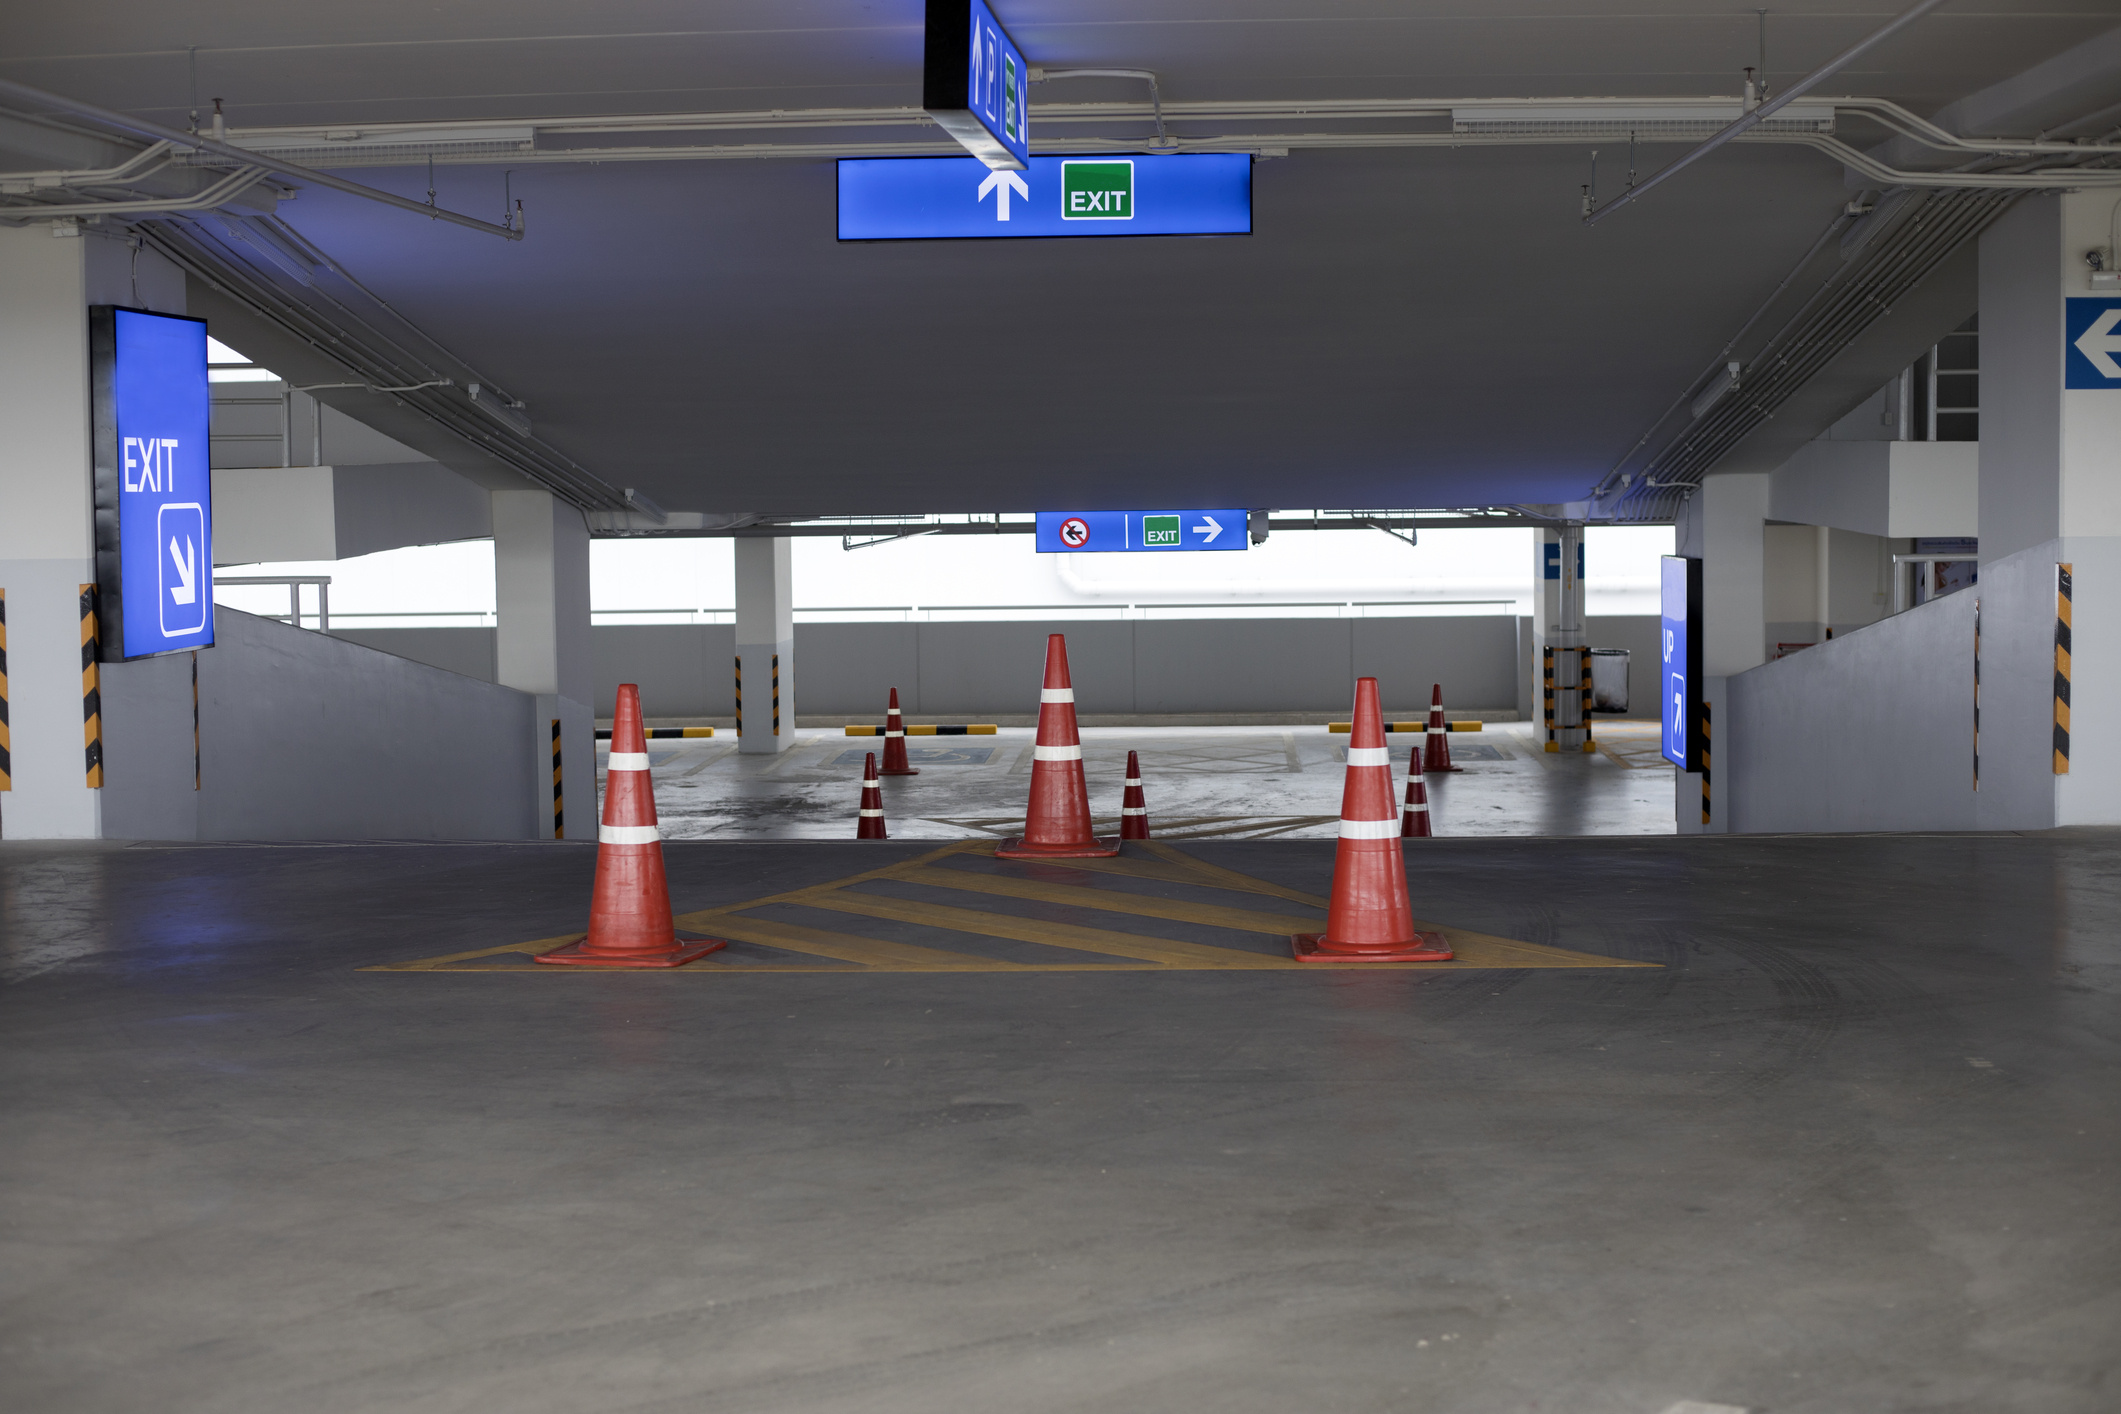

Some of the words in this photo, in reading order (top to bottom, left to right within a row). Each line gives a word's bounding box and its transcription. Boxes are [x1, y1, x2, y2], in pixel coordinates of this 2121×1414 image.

[1071, 191, 1126, 211] EXIT
[124, 437, 178, 492] EXIT
[1148, 530, 1177, 542] EXIT
[1663, 628, 1674, 664] UP
